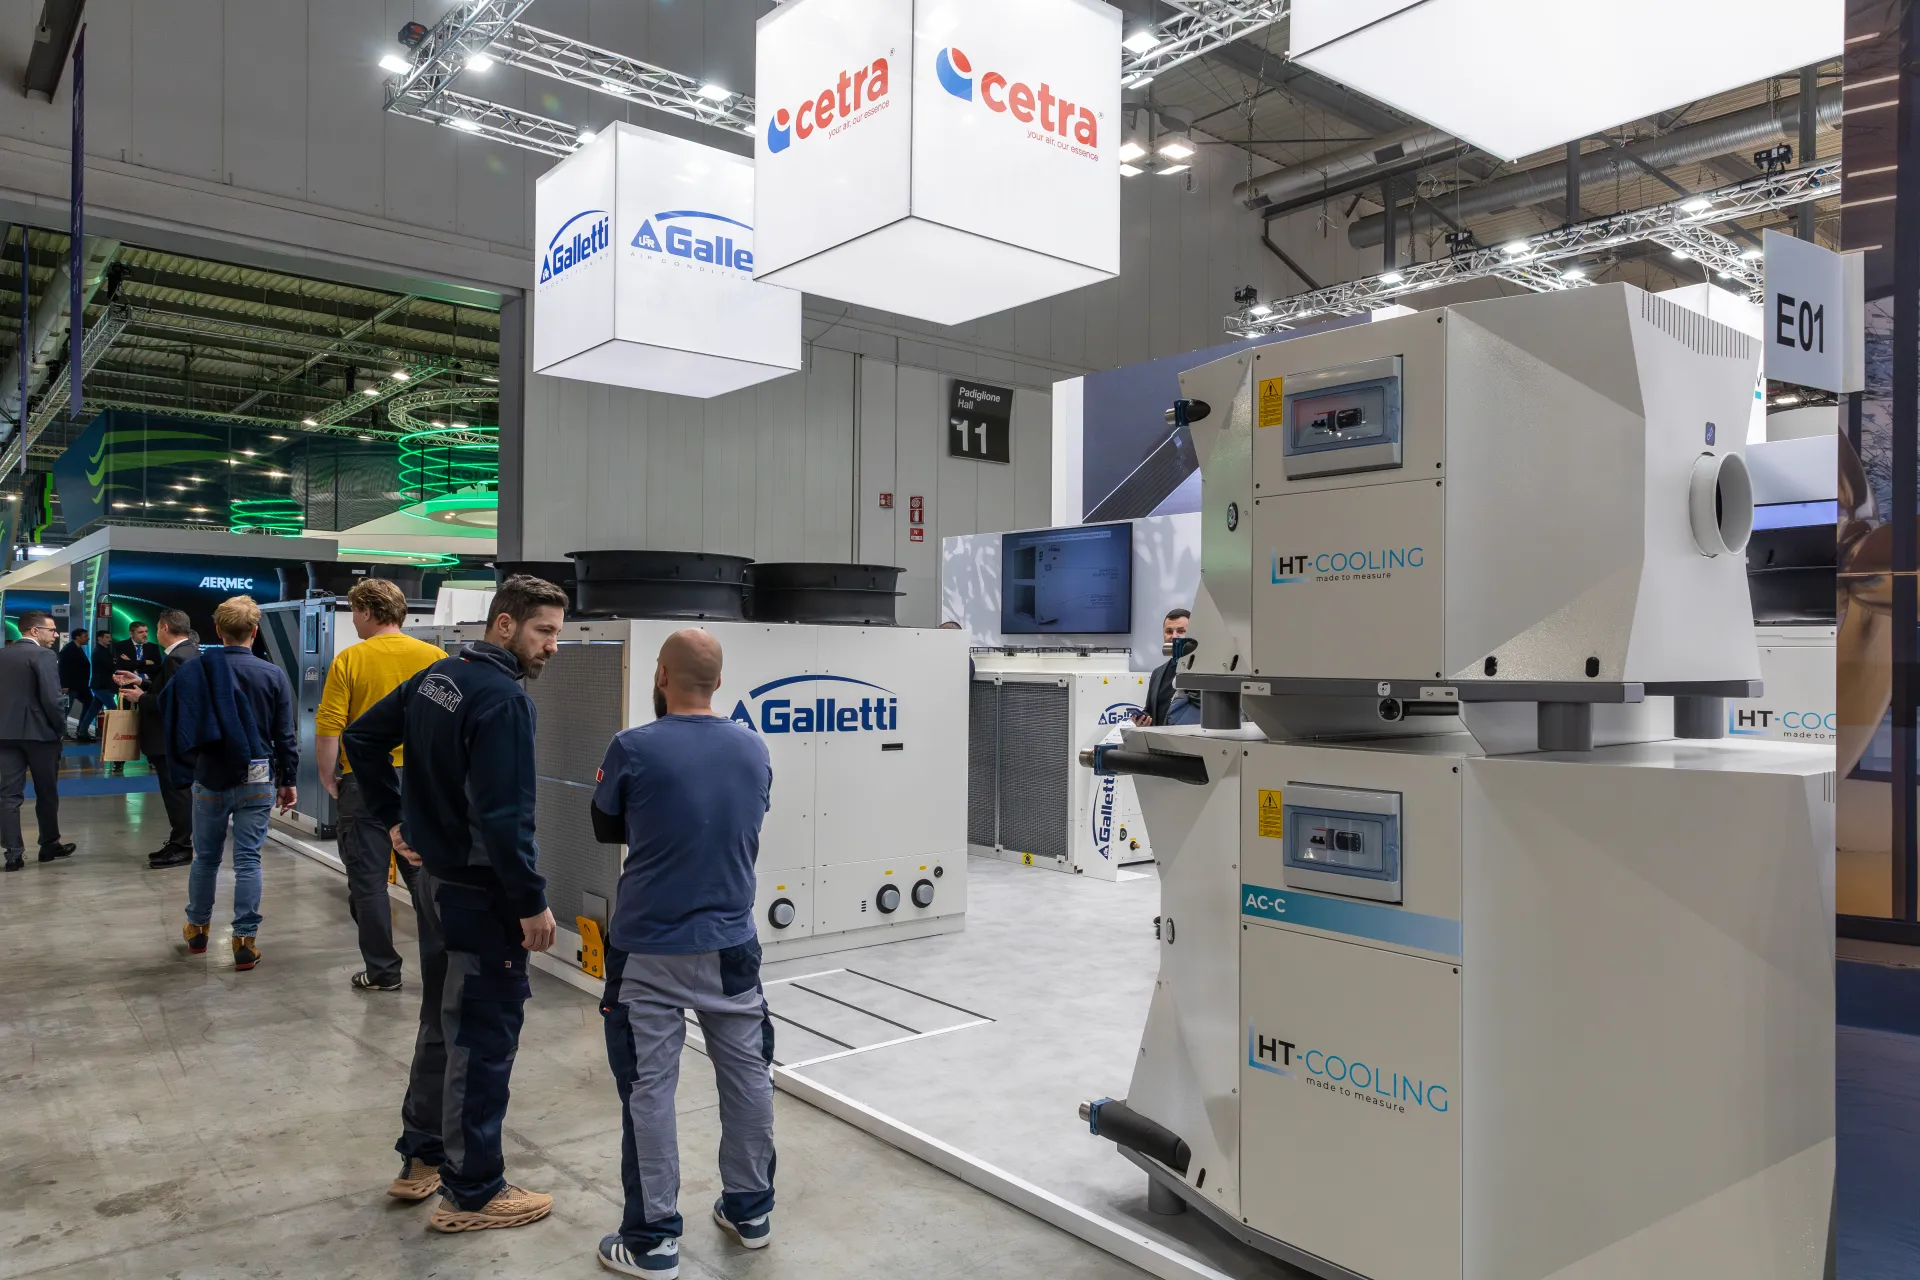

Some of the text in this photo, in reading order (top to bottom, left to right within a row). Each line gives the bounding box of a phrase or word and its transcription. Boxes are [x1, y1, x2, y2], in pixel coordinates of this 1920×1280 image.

[796, 58, 888, 139] cetra
[981, 71, 1097, 148] cetra
[828, 125, 841, 139] your
[852, 113, 863, 125] our
[864, 100, 890, 119] essence
[1027, 129, 1099, 161] your air, our essence
[553, 215, 609, 276] Galletti
[666, 225, 753, 273] Galle
[1777, 293, 1823, 353] E01
[957, 399, 974, 410] Hall
[959, 386, 1001, 403] Padiglione
[956, 420, 987, 454] 11
[1279, 547, 1424, 575] HT-COOLING
[1316, 574, 1339, 582] made
[1353, 572, 1392, 580] measure
[199, 576, 253, 591] AERMEC
[762, 698, 897, 733] Galletti
[1738, 709, 1837, 731] HT-COO
[1783, 731, 1811, 739] made
[1246, 893, 1286, 913] AC-C
[1258, 1034, 1448, 1113] HT-COOLING
[1306, 1076, 1405, 1114] made to measure
